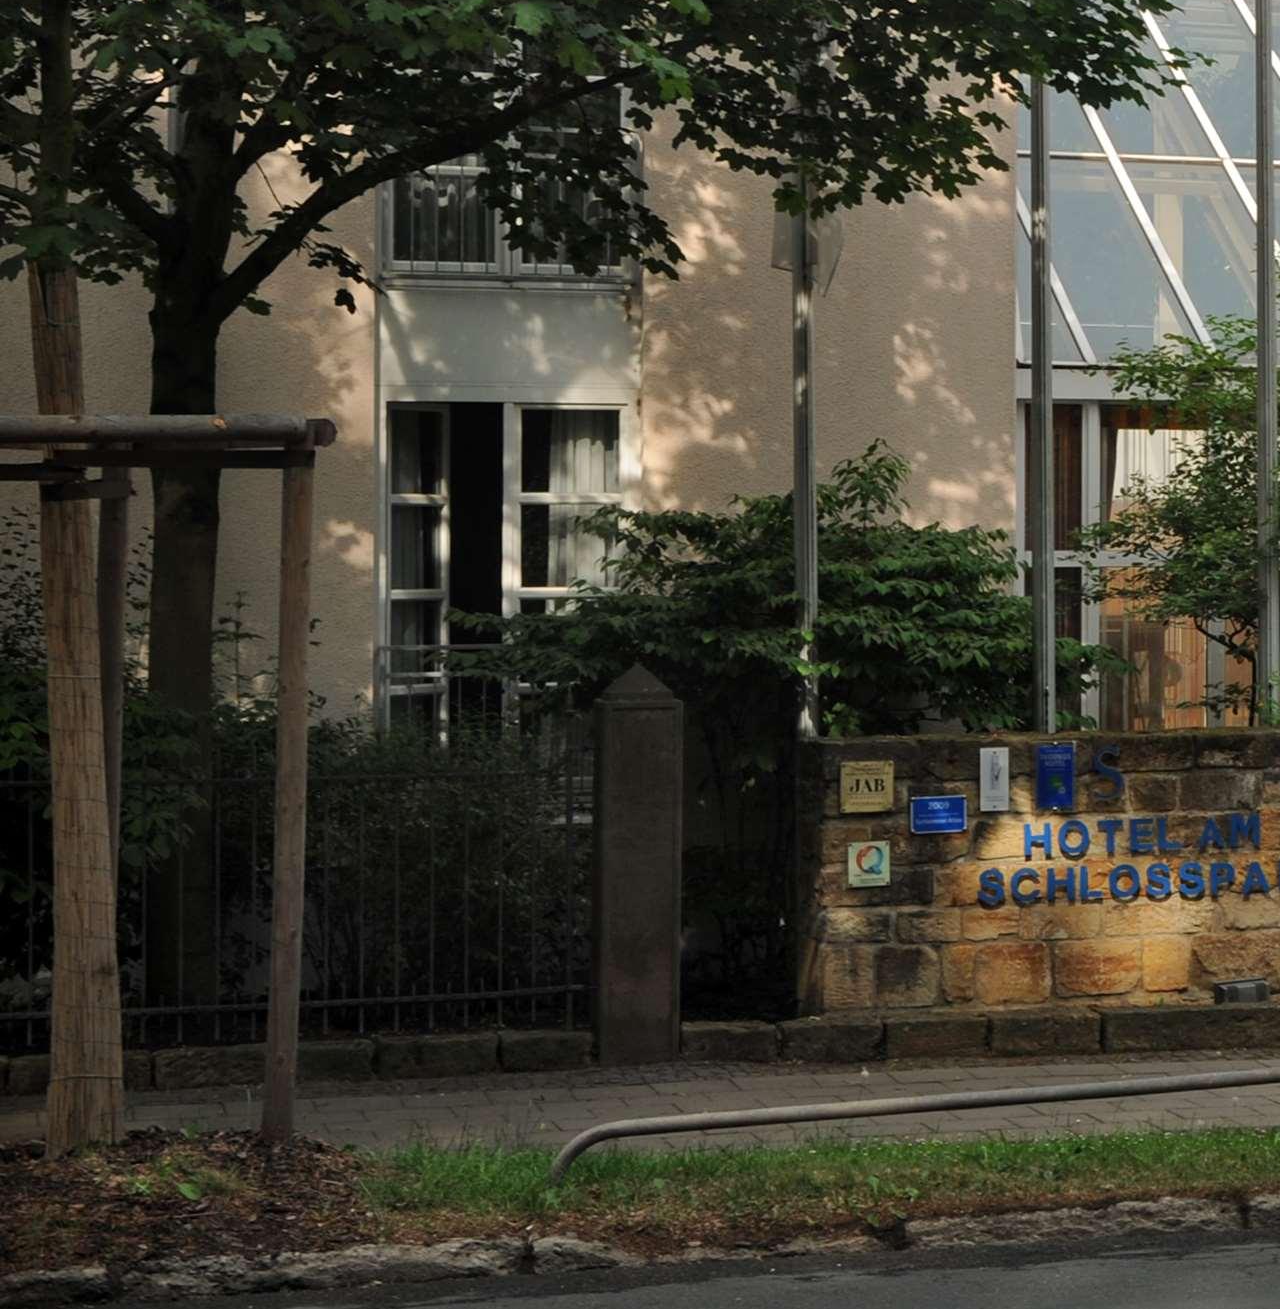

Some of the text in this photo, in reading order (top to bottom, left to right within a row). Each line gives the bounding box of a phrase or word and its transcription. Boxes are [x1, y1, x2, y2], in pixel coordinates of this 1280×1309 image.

[848, 778, 885, 793] JAB
[1093, 745, 1125, 801] S
[1023, 812, 1262, 860] HOTEL AM
